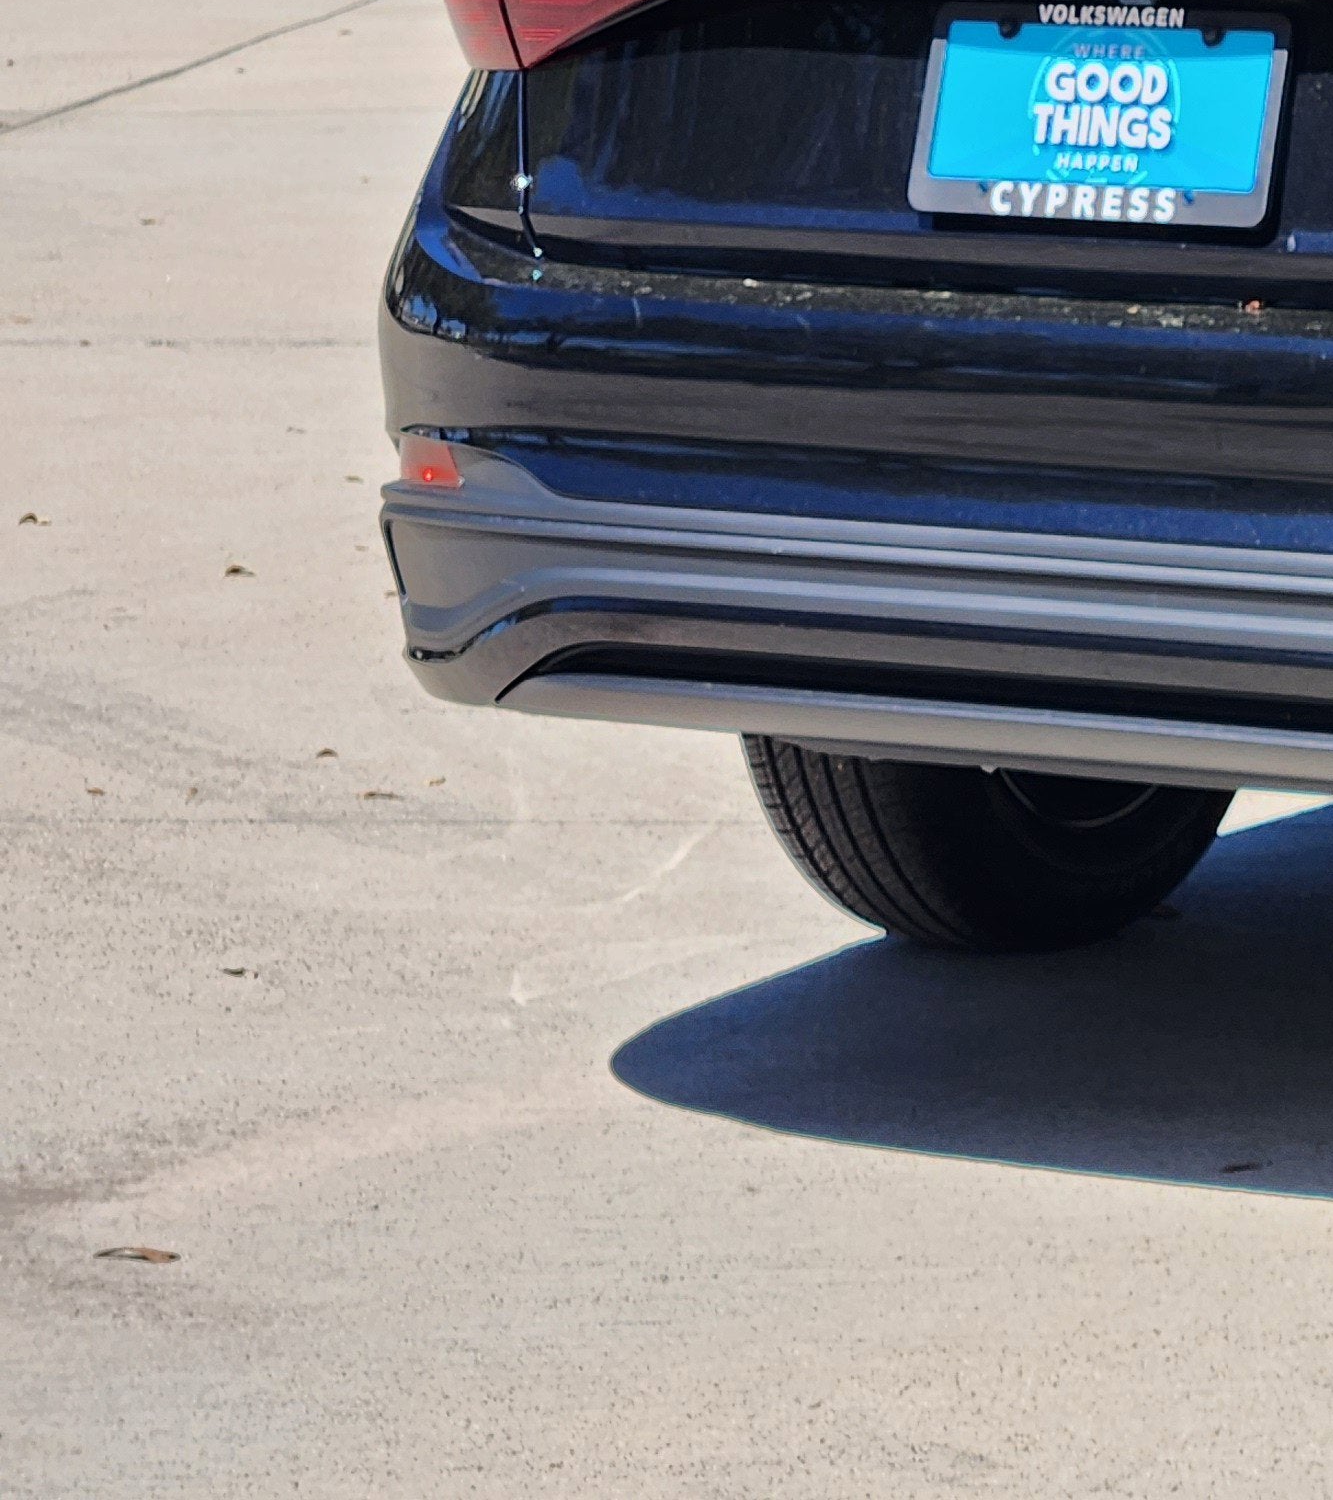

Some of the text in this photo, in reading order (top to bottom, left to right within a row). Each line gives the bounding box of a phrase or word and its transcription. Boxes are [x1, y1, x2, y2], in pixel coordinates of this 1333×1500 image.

[1038, 4, 1186, 28] VOLKSWAGEN
[1073, 43, 1146, 60] WHERE
[1045, 60, 1169, 105] GOOD
[1033, 103, 1173, 150] THINGS
[1055, 151, 1139, 173] HAPPEN
[989, 180, 1177, 224] CYPRESS
